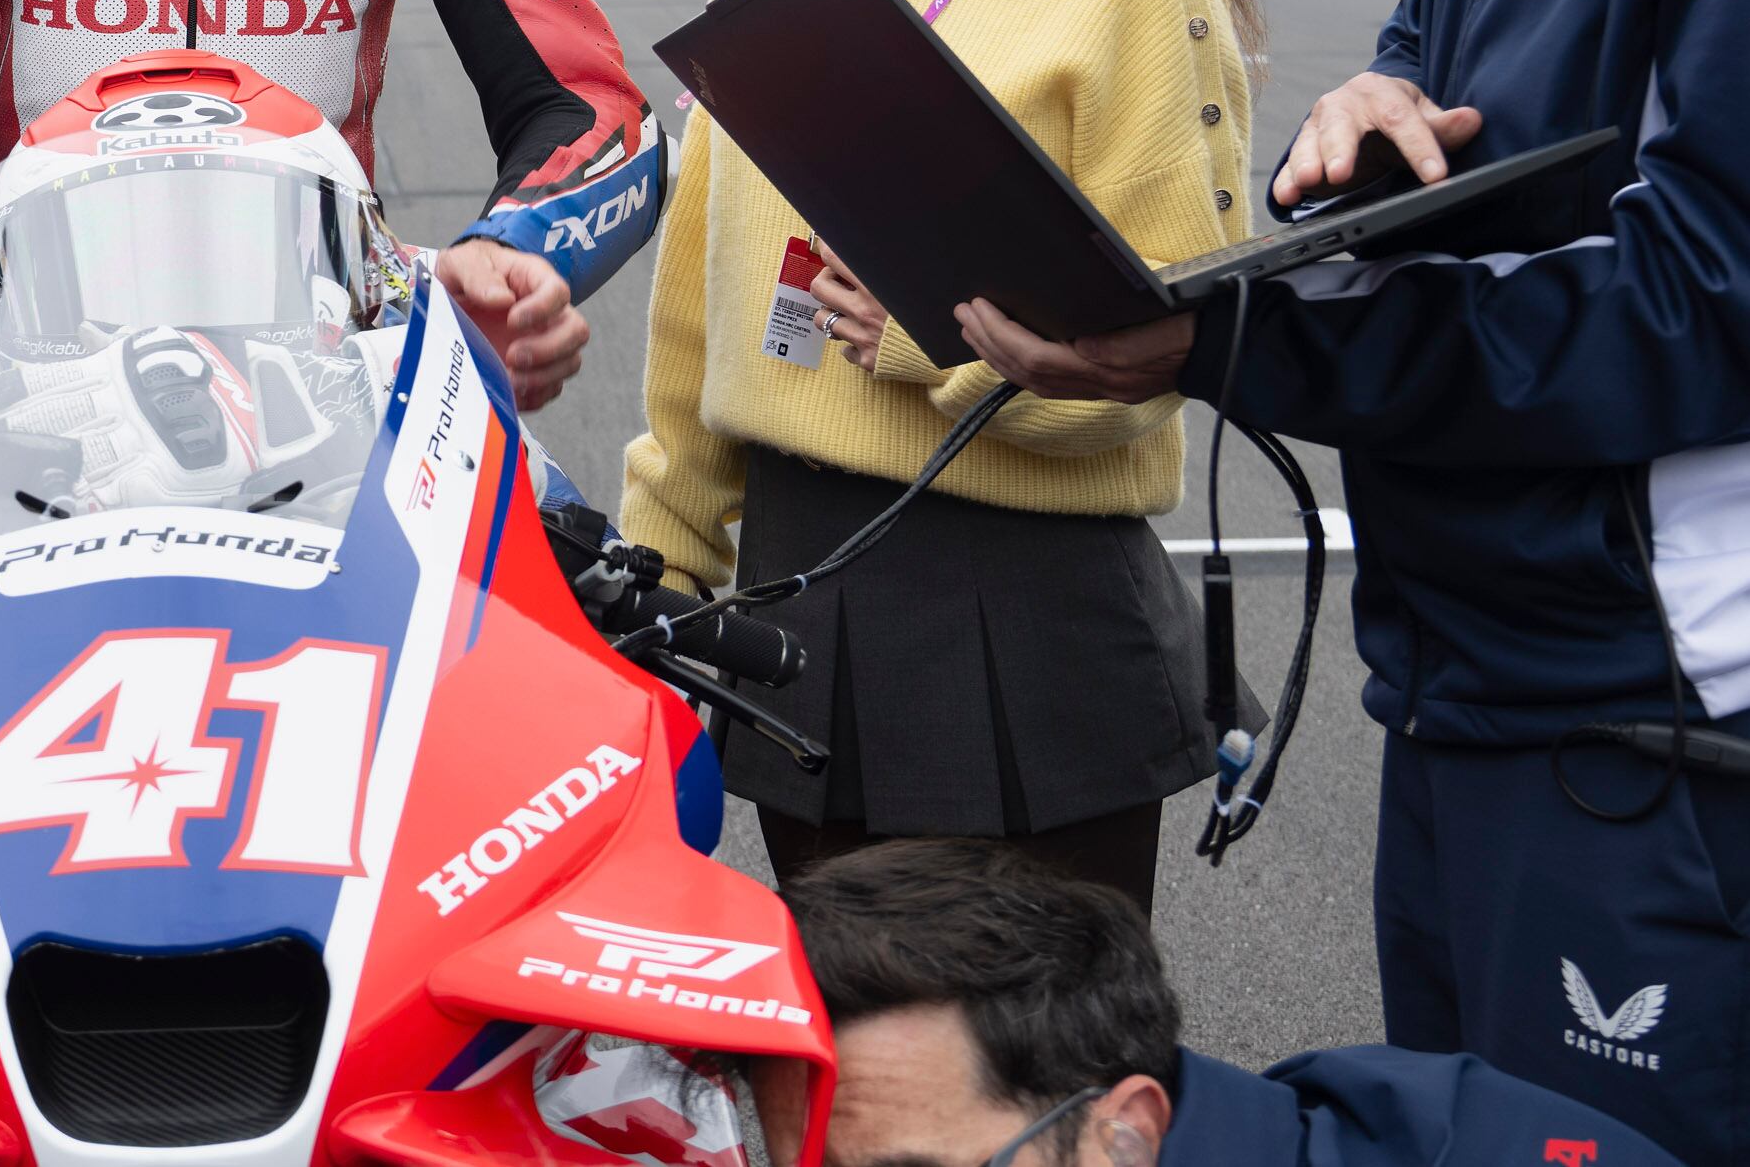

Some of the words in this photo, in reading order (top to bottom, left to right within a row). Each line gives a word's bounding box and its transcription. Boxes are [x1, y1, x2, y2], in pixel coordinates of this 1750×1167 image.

[101, 129, 240, 154] Kabuto
[544, 174, 648, 253] IXON
[417, 745, 643, 917] HONDA
[1563, 1028, 1661, 1071] CASTORE
